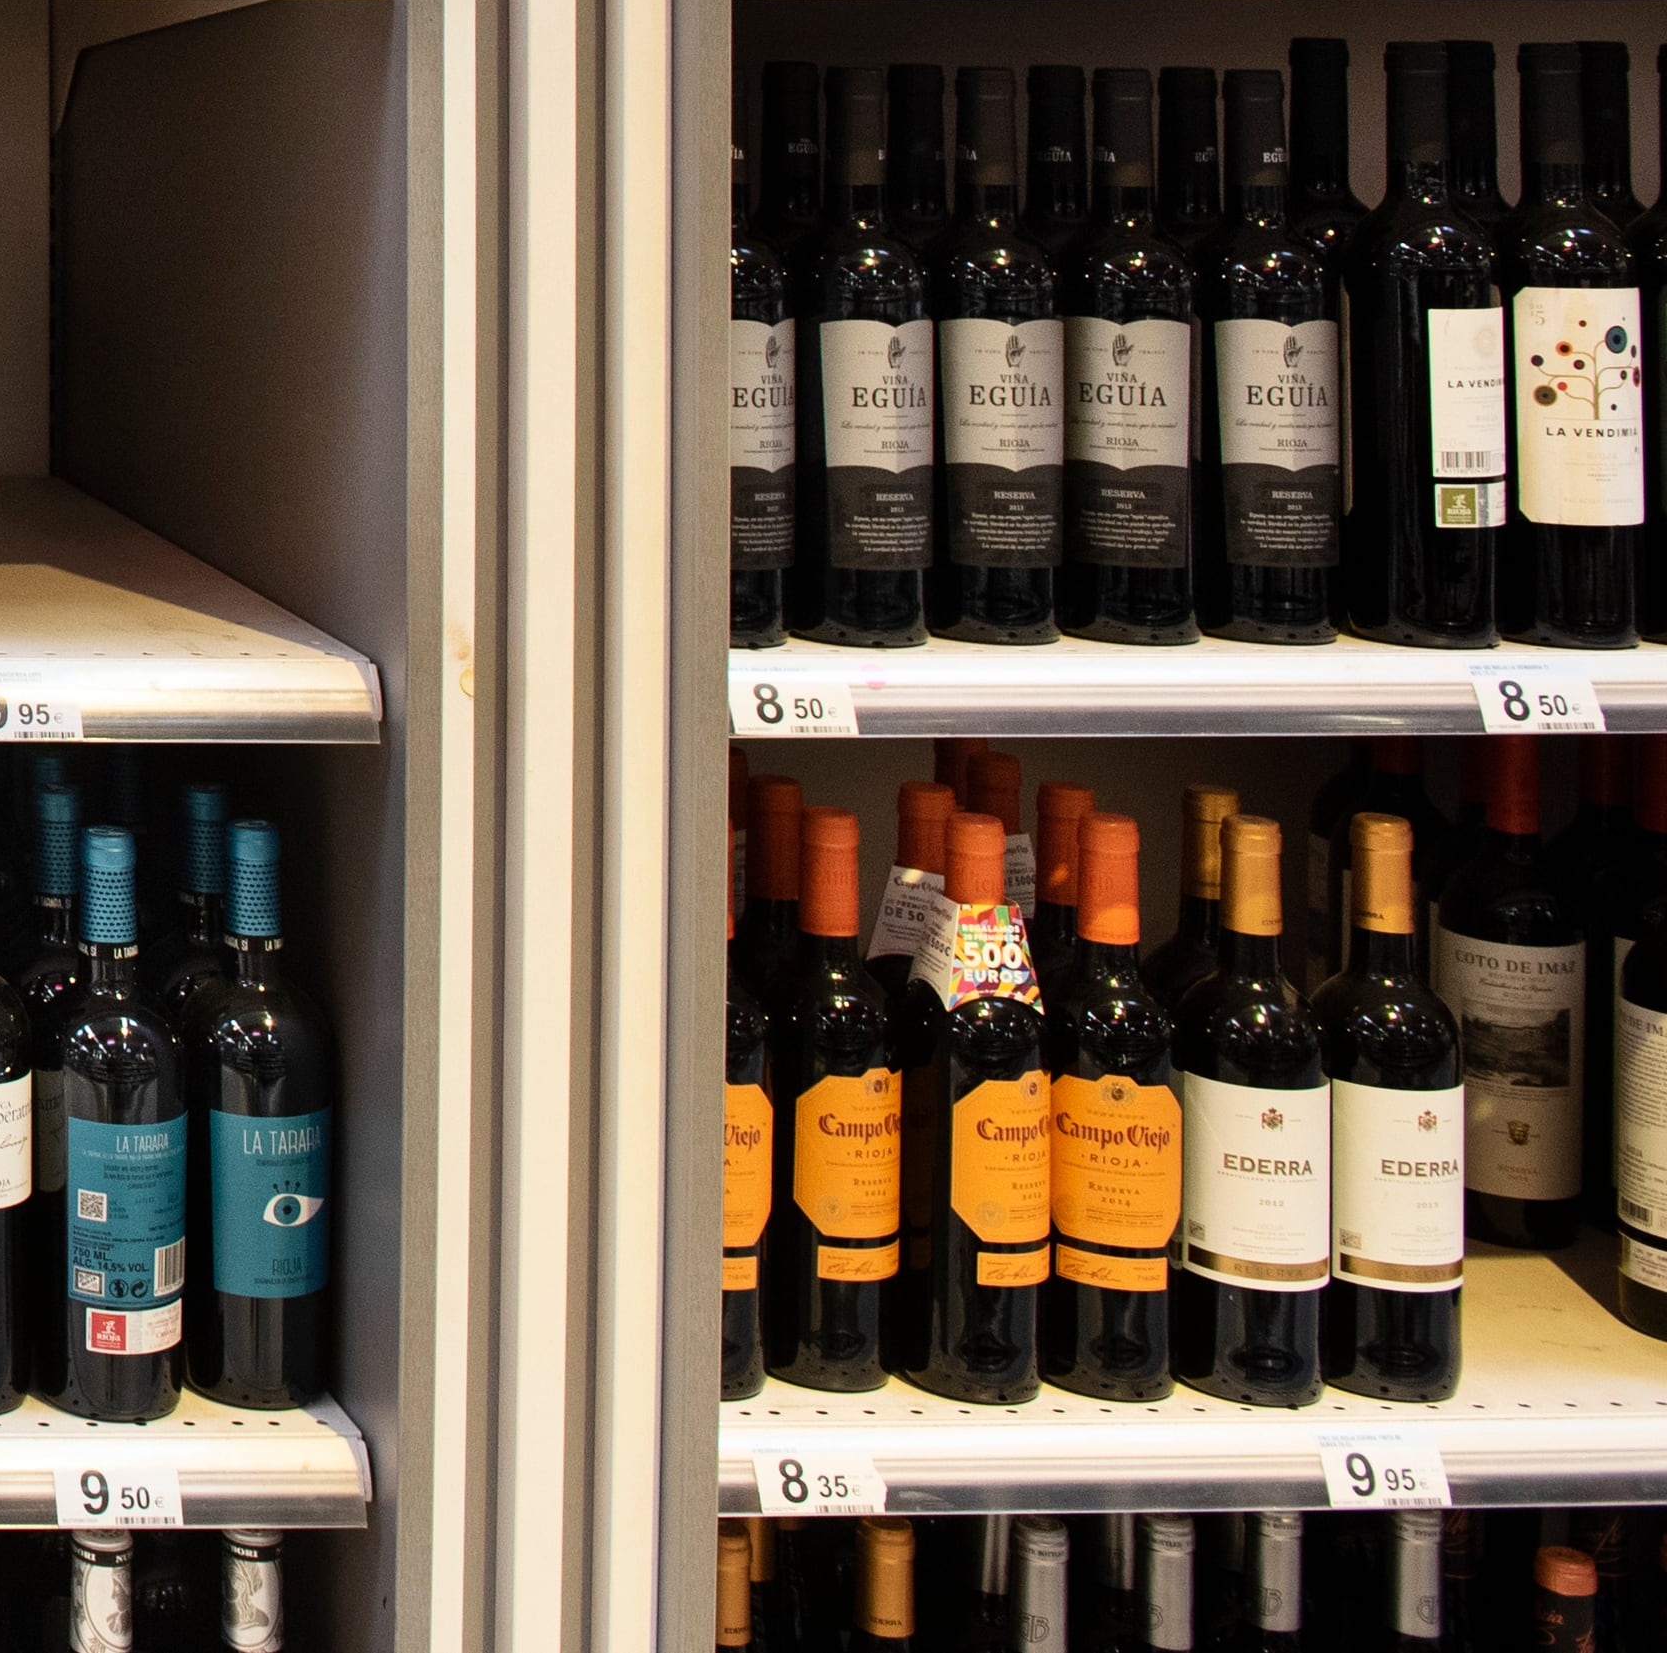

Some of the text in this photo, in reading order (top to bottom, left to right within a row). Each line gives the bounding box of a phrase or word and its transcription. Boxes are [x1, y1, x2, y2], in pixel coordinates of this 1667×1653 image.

[999, 374, 1029, 385] VIÑA
[968, 380, 1052, 408] EGUÍA
[1545, 426, 1639, 438] LA VENDIMIA
[18, 703, 50, 725] 95
[753, 683, 824, 724] 8 50
[1498, 680, 1568, 722] 8 50
[964, 941, 1024, 970] 500
[1506, 957, 1531, 975] DE
[963, 969, 1024, 985] EUROS
[243, 1124, 322, 1156] LA TARARA
[1056, 1111, 1171, 1155] Campo Viejo
[1222, 1151, 1314, 1176] EDERRA
[1087, 1181, 1141, 1197] RESERVA
[778, 1458, 849, 1504] 8 35
[1345, 1451, 1416, 1497] 9 95
[80, 1470, 151, 1516] 9 50
